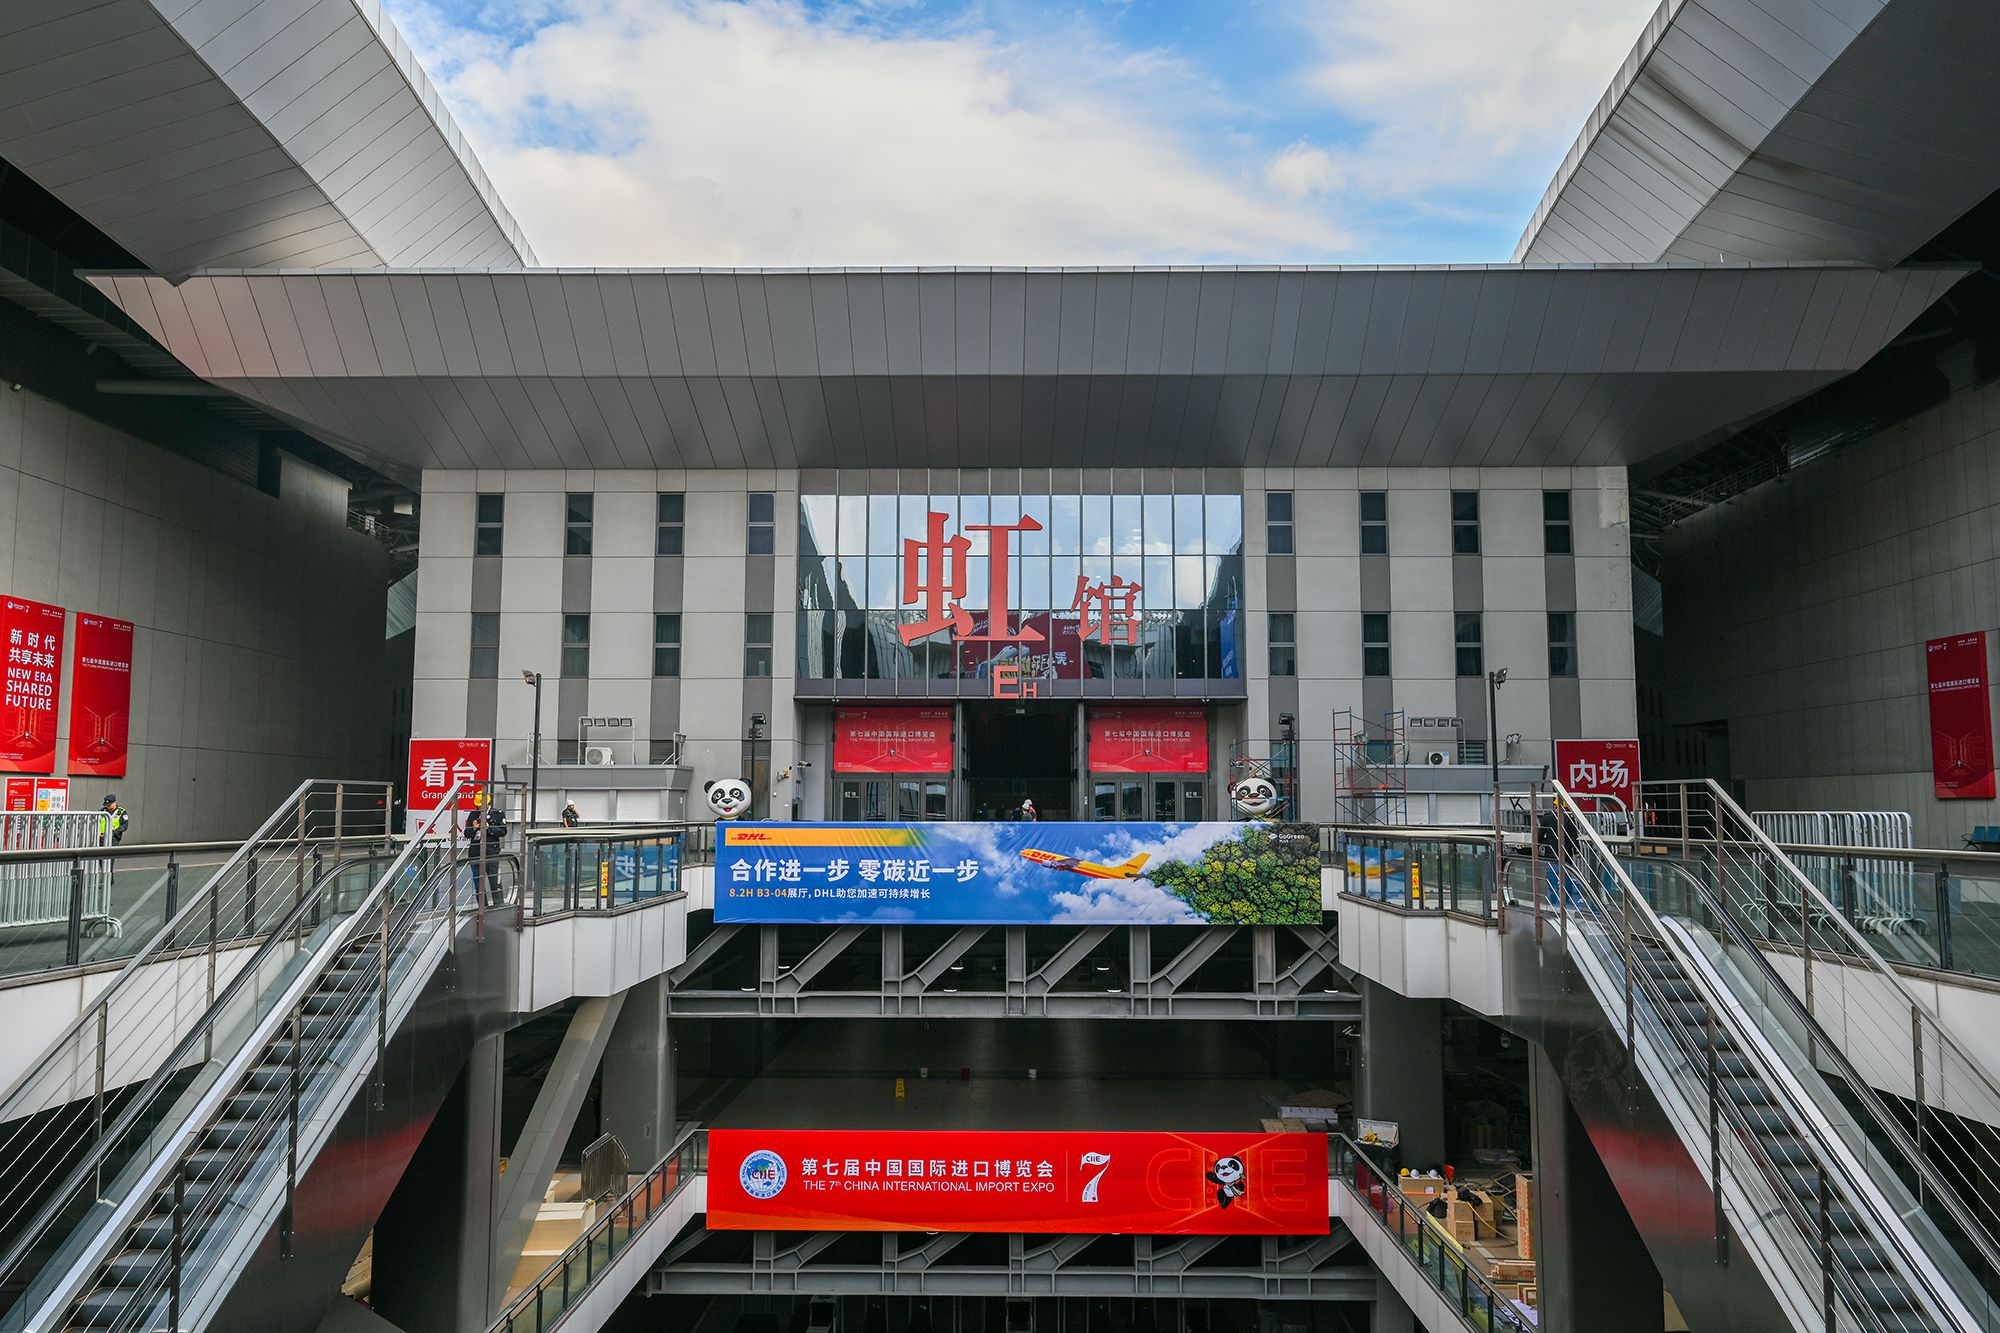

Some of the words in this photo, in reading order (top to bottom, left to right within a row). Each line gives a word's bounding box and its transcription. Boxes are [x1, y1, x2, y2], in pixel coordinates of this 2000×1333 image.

[897, 511, 1142, 646] 虹馆
[10, 628, 56, 651] 新时代
[9, 647, 54, 668] 共享未来
[8, 667, 31, 680] NEW
[34, 670, 53, 683] ERA
[6, 680, 52, 697] SHARED
[5, 694, 51, 710] FUTURE
[420, 757, 478, 787] 看台
[1569, 759, 1629, 788] 内场
[730, 858, 850, 882] 合作进一步
[858, 859, 979, 882] 零碳近一步
[729, 888, 754, 898] 8.2H
[751, 1169, 775, 1180] CIIE
[801, 1158, 1053, 1177] 第七届中国国际进口博览会
[803, 1181, 826, 1190] THE
[844, 1181, 880, 1191] CHINA
[882, 1181, 972, 1192] INTERNATIONAL
[975, 1182, 1020, 1192] IMPORT
[1022, 1182, 1055, 1192] EXPO
